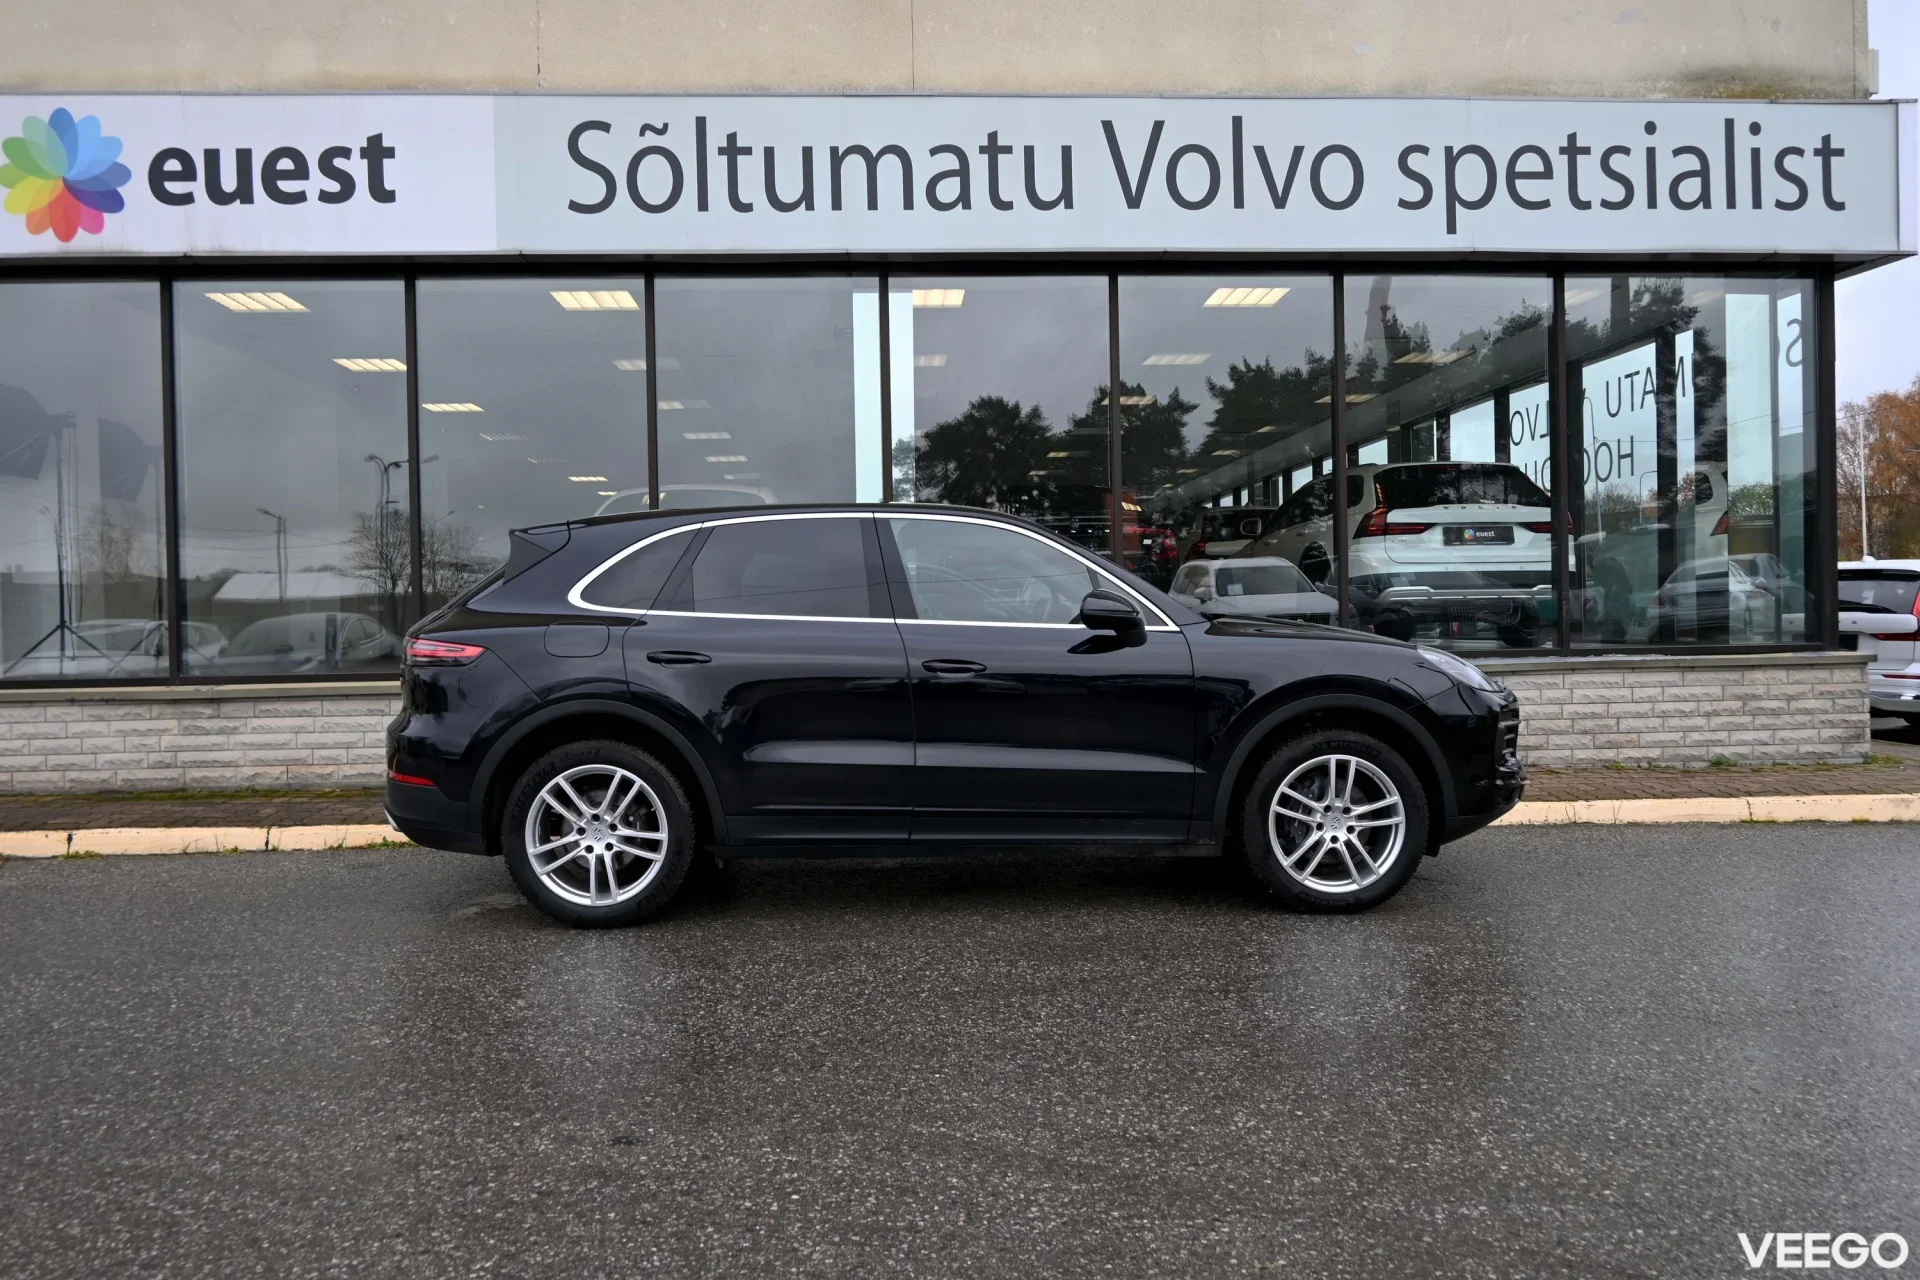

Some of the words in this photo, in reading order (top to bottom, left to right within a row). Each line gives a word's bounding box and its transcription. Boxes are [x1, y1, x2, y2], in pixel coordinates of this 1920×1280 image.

[147, 132, 396, 207] euest
[567, 115, 1074, 215] Sõltumatu
[1100, 115, 1365, 211] Volvo
[1397, 117, 1846, 235] spetsialist
[1475, 530, 1495, 538] euest
[1329, 741, 1380, 757] MICHELIN
